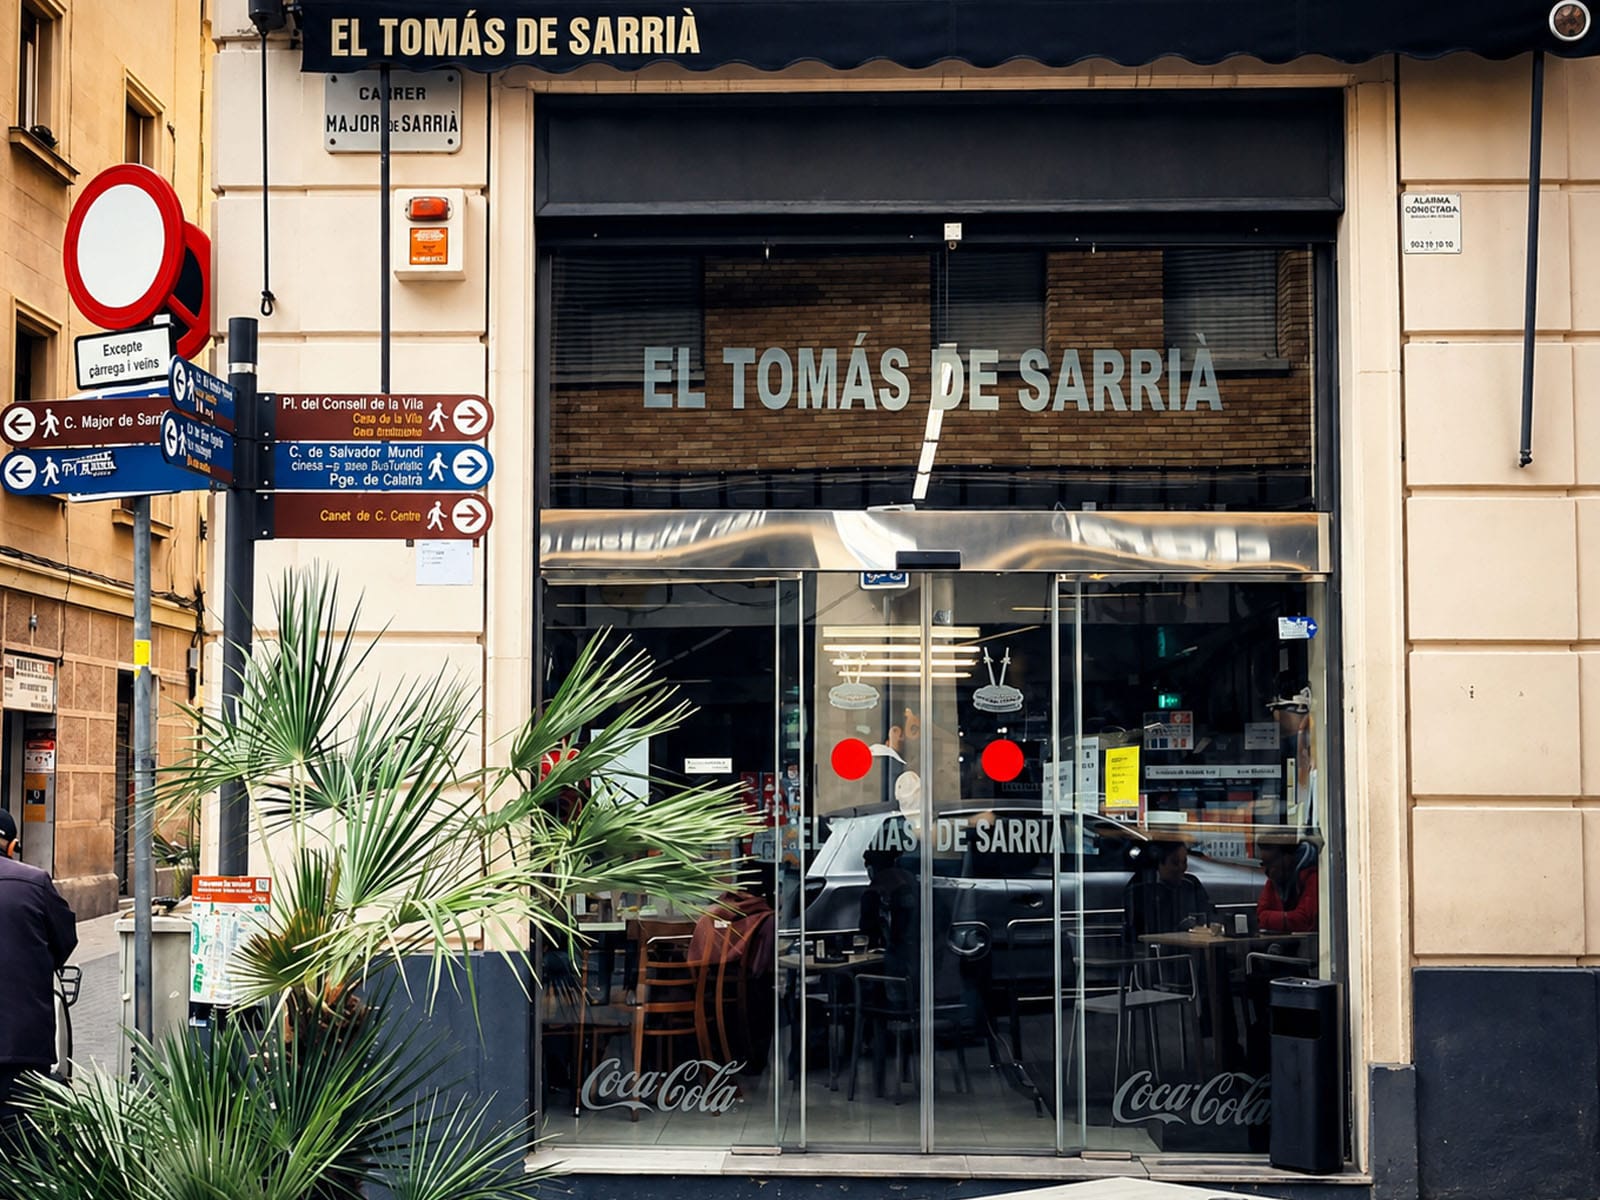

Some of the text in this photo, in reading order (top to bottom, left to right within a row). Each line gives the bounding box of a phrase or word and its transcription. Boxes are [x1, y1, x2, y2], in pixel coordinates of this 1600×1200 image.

[331, 8, 701, 56] EL TOMÁS DE SARRIÀ
[359, 87, 426, 100] CARER
[326, 114, 380, 132] MAJOR
[402, 110, 458, 132] SARRIÀ
[102, 341, 143, 357] Excepte
[127, 360, 131, 372] i
[643, 332, 1223, 412] EL TOMÁS DE SARRIÀ
[282, 397, 424, 410] Pl. del Consell de la Vila
[64, 416, 77, 429] C.
[81, 415, 113, 431] Major
[118, 413, 133, 427] de
[289, 445, 424, 458] C. de Salvador Mundi
[329, 473, 358, 489] Pge.
[363, 473, 379, 486] de
[320, 509, 421, 522] Canet de C. Centre
[800, 816, 824, 850] EL
[936, 819, 968, 852] DE
[581, 1057, 748, 1113] Coca-Cola
[1112, 1070, 1272, 1126] Coca-Cola
